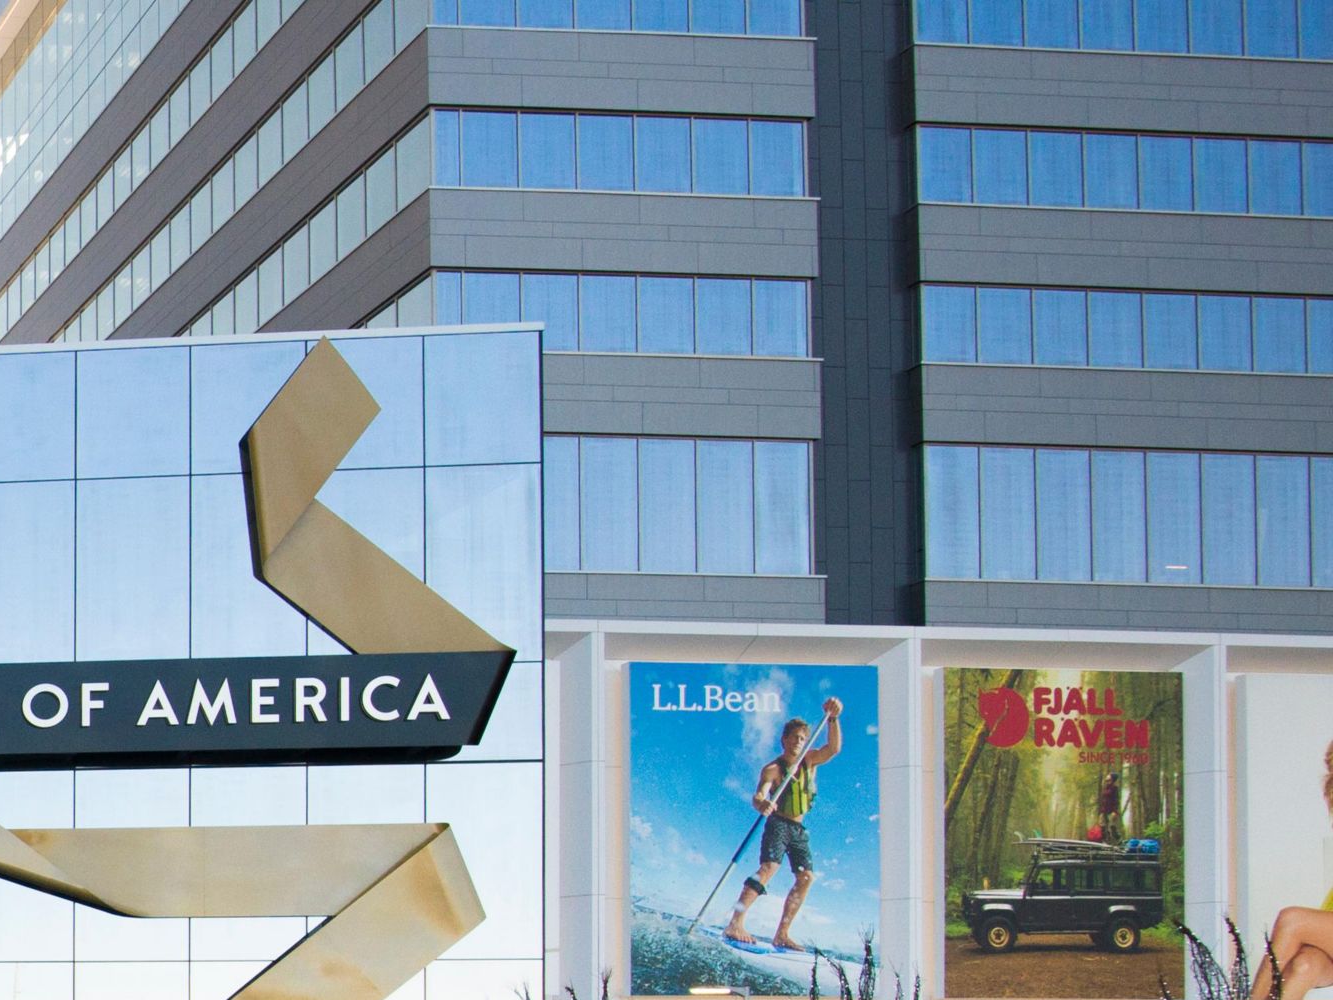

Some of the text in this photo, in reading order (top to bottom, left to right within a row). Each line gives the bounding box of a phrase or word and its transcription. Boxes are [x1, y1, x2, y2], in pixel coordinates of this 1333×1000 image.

[21, 682, 110, 728] OF
[136, 673, 451, 726] AMERICA
[652, 683, 781, 712] L.L.Bean
[1033, 686, 1124, 716] FJÄLL
[1033, 717, 1150, 749] RÄVEN
[1078, 751, 1150, 765] SINCE 1960
